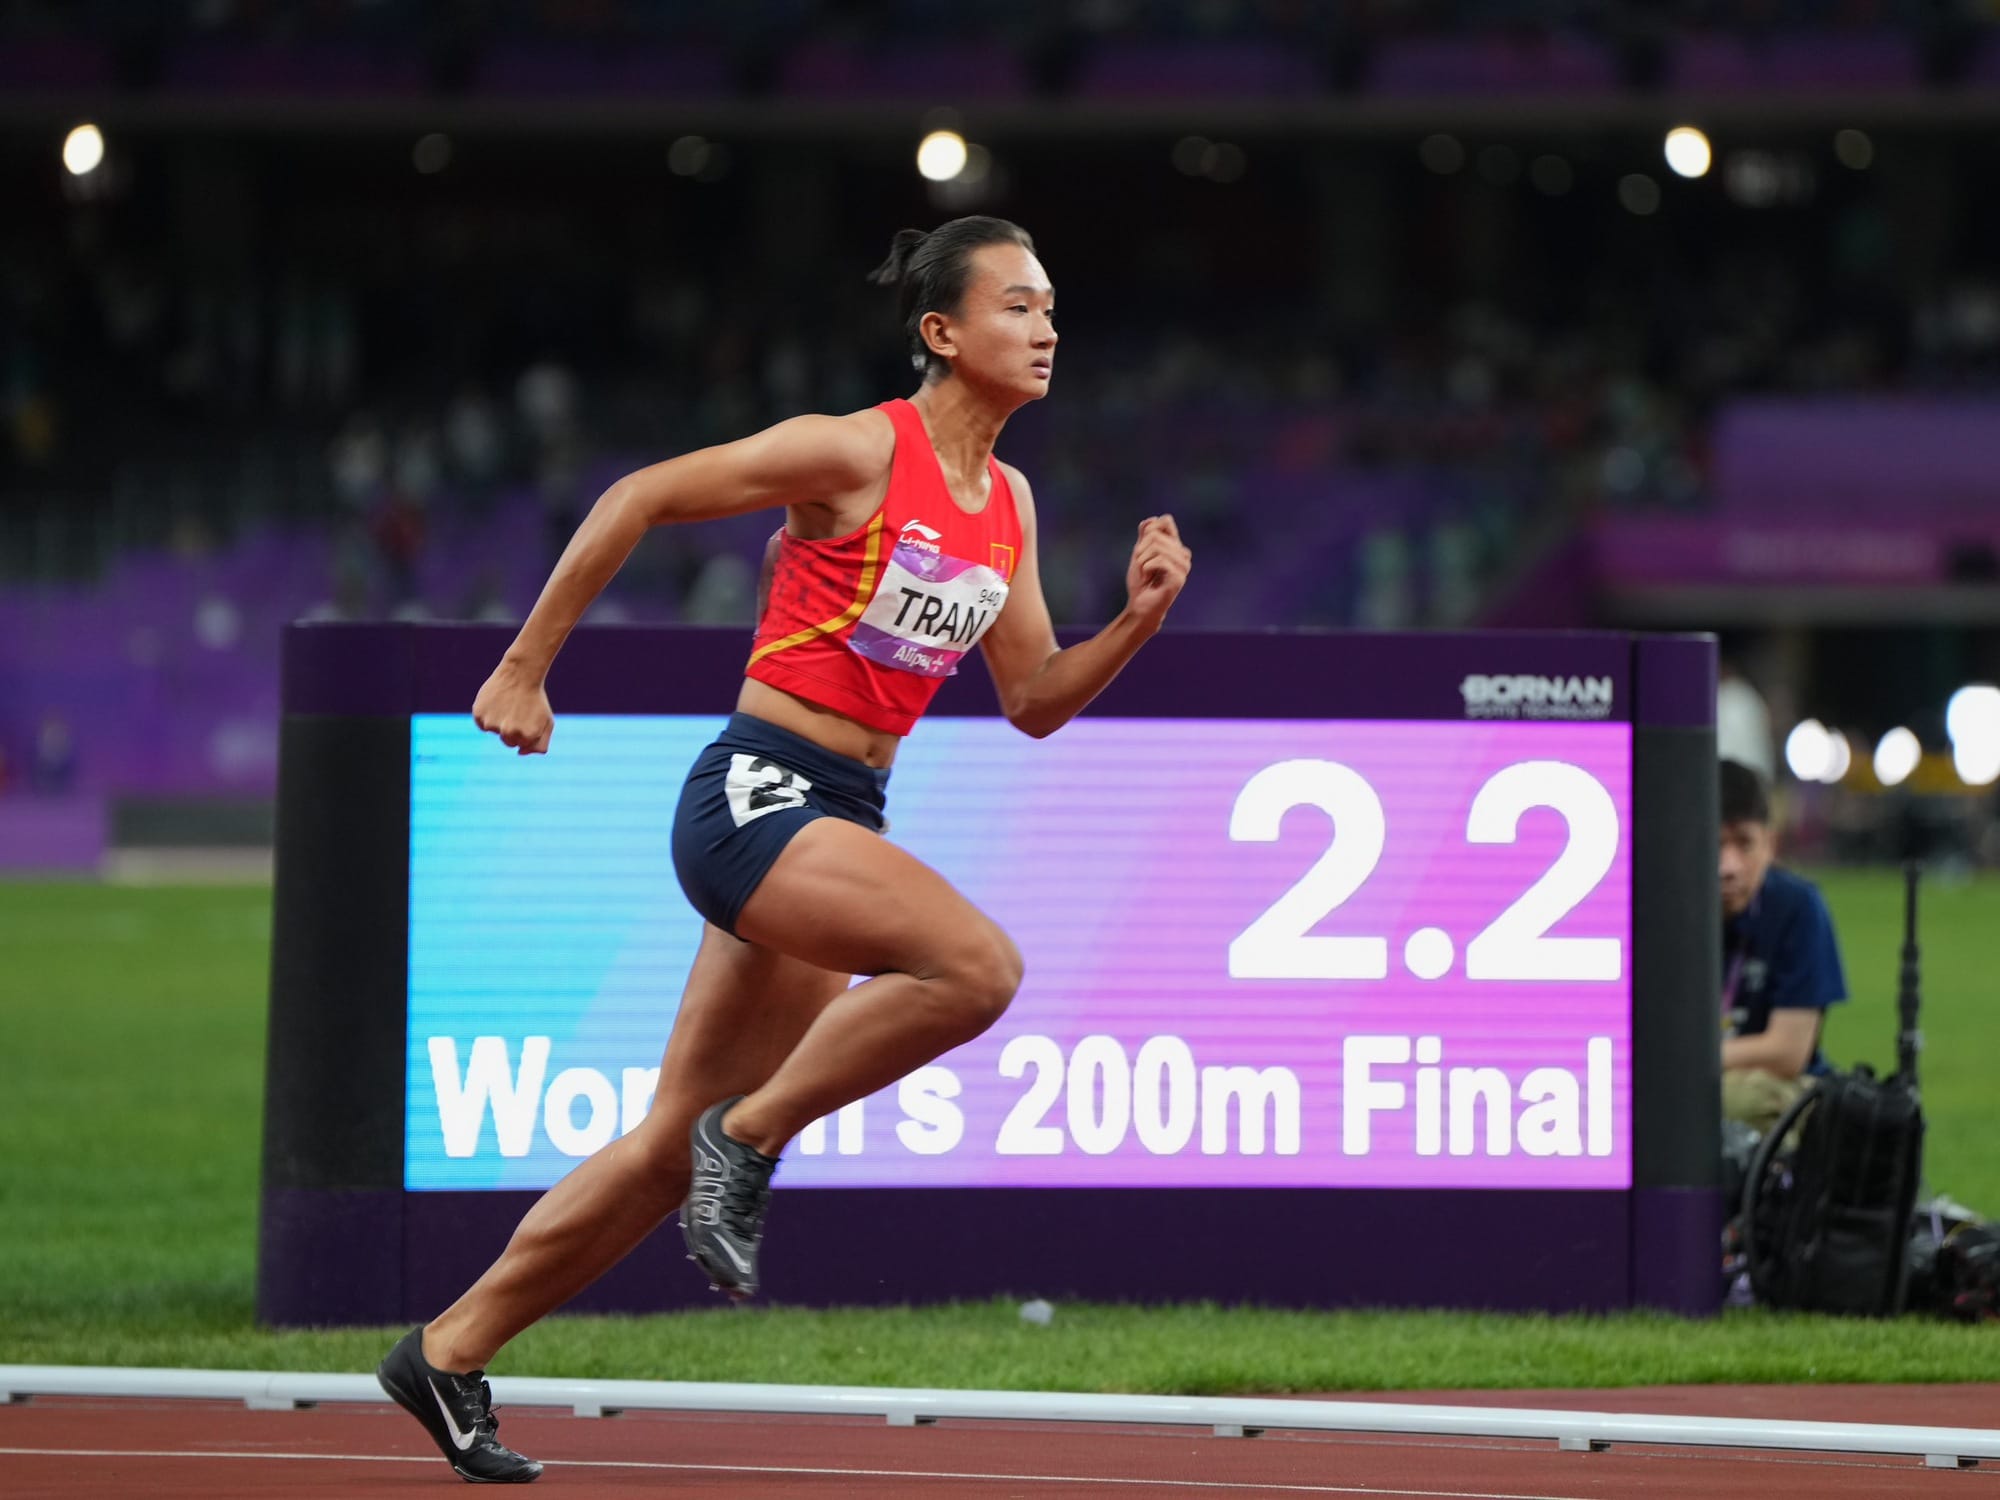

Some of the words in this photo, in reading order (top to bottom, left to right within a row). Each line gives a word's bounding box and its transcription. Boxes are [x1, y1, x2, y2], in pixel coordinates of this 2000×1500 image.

[893, 586, 988, 645] TRAN
[1459, 674, 1613, 703] BORNAN
[1229, 758, 1622, 981] 2.2
[995, 1034, 1300, 1155] 200m
[1342, 1035, 1613, 1156] Final
